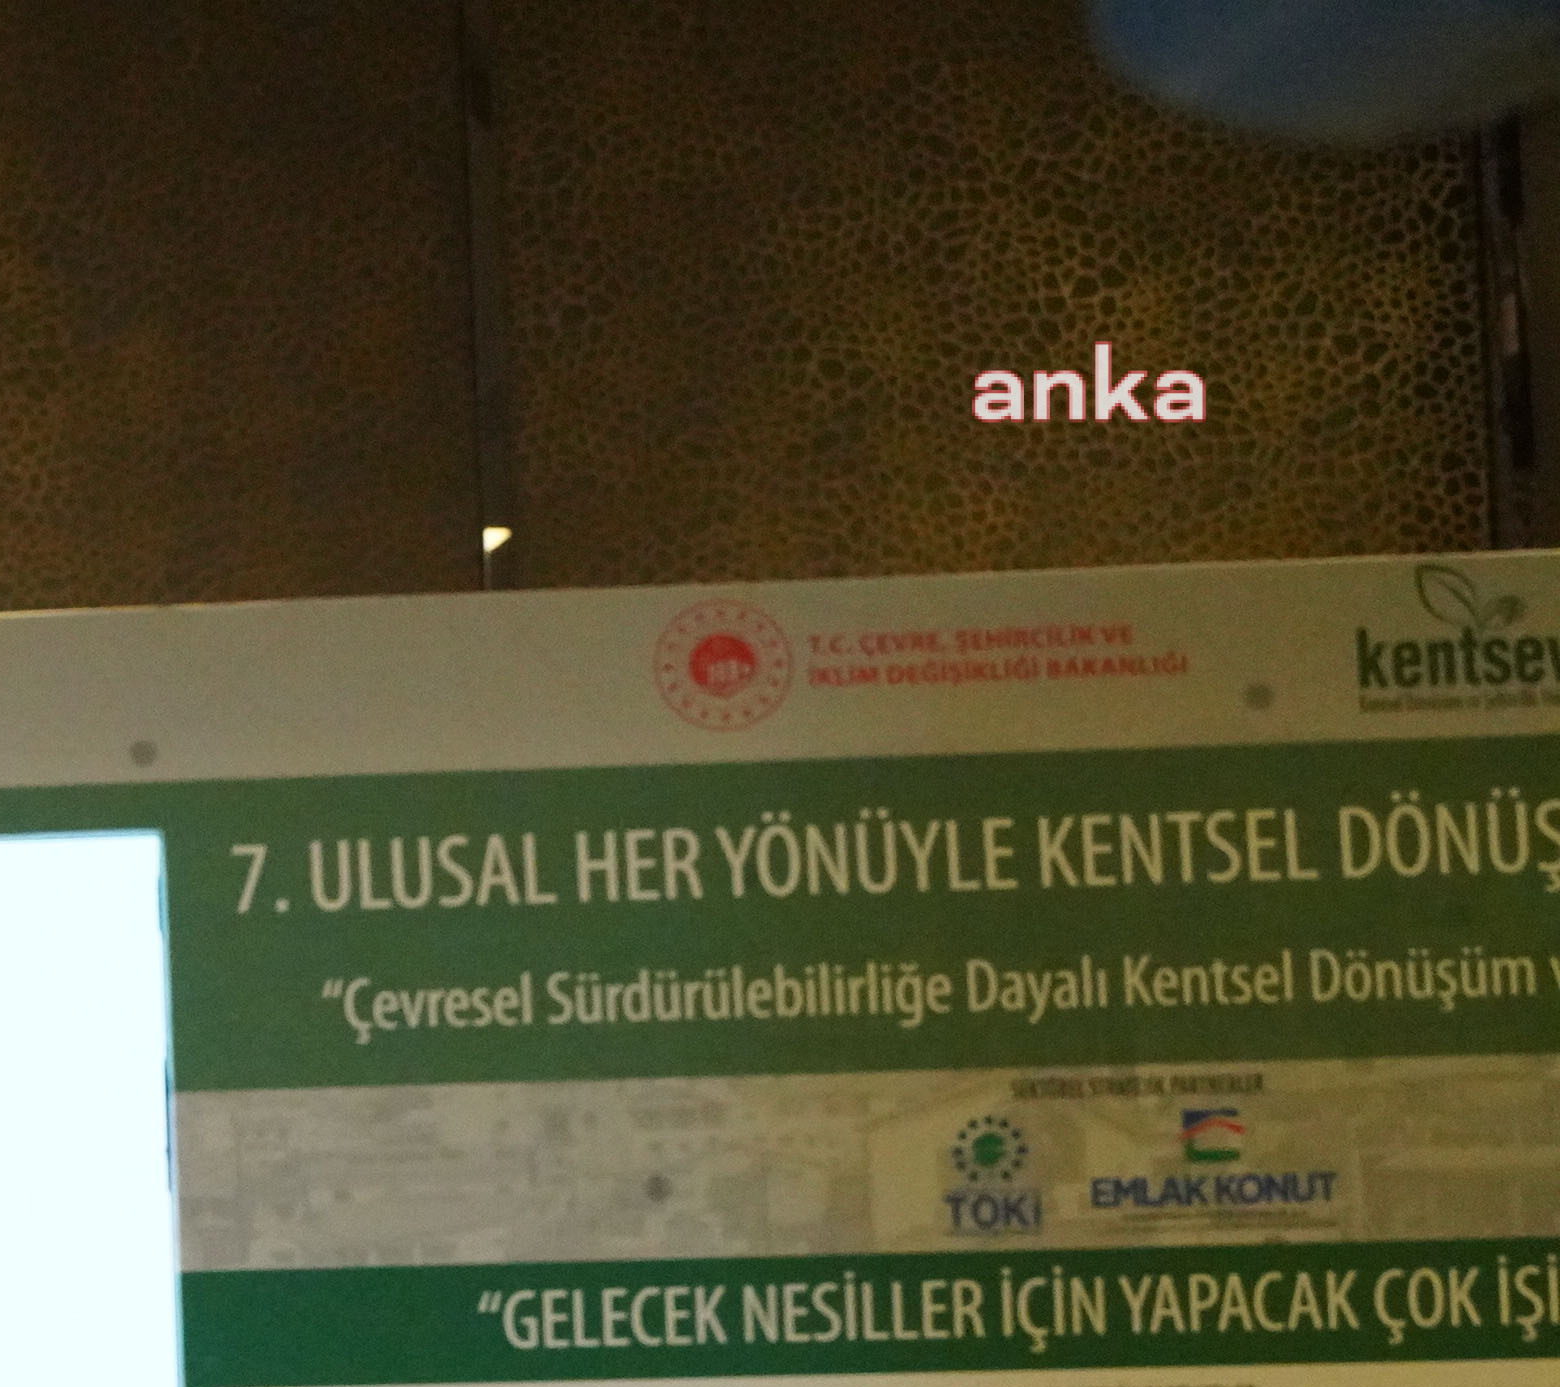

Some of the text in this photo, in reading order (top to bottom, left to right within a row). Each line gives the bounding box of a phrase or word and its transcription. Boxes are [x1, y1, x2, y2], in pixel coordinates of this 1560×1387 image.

[231, 843, 289, 914] 7.
[309, 832, 558, 913] ULUSAL
[576, 828, 703, 903] HER
[716, 807, 1018, 899] YÖNÜYLE
[1037, 808, 1319, 888] KENTSEL
[547, 960, 953, 1029] Sürdürülebilirliğe
[966, 954, 1108, 1024] Dayalı
[1123, 948, 1295, 1006] Kentsel
[1310, 945, 1538, 1013] Dönüşüm
[1091, 1171, 1337, 1208] EMLAK KONUT
[743, 1271, 986, 1344] NESİLLER
[1001, 1266, 1107, 1354] İÇİN
[1120, 1269, 1360, 1334] YAPACAK
[1374, 1267, 1481, 1345] ÇOK
